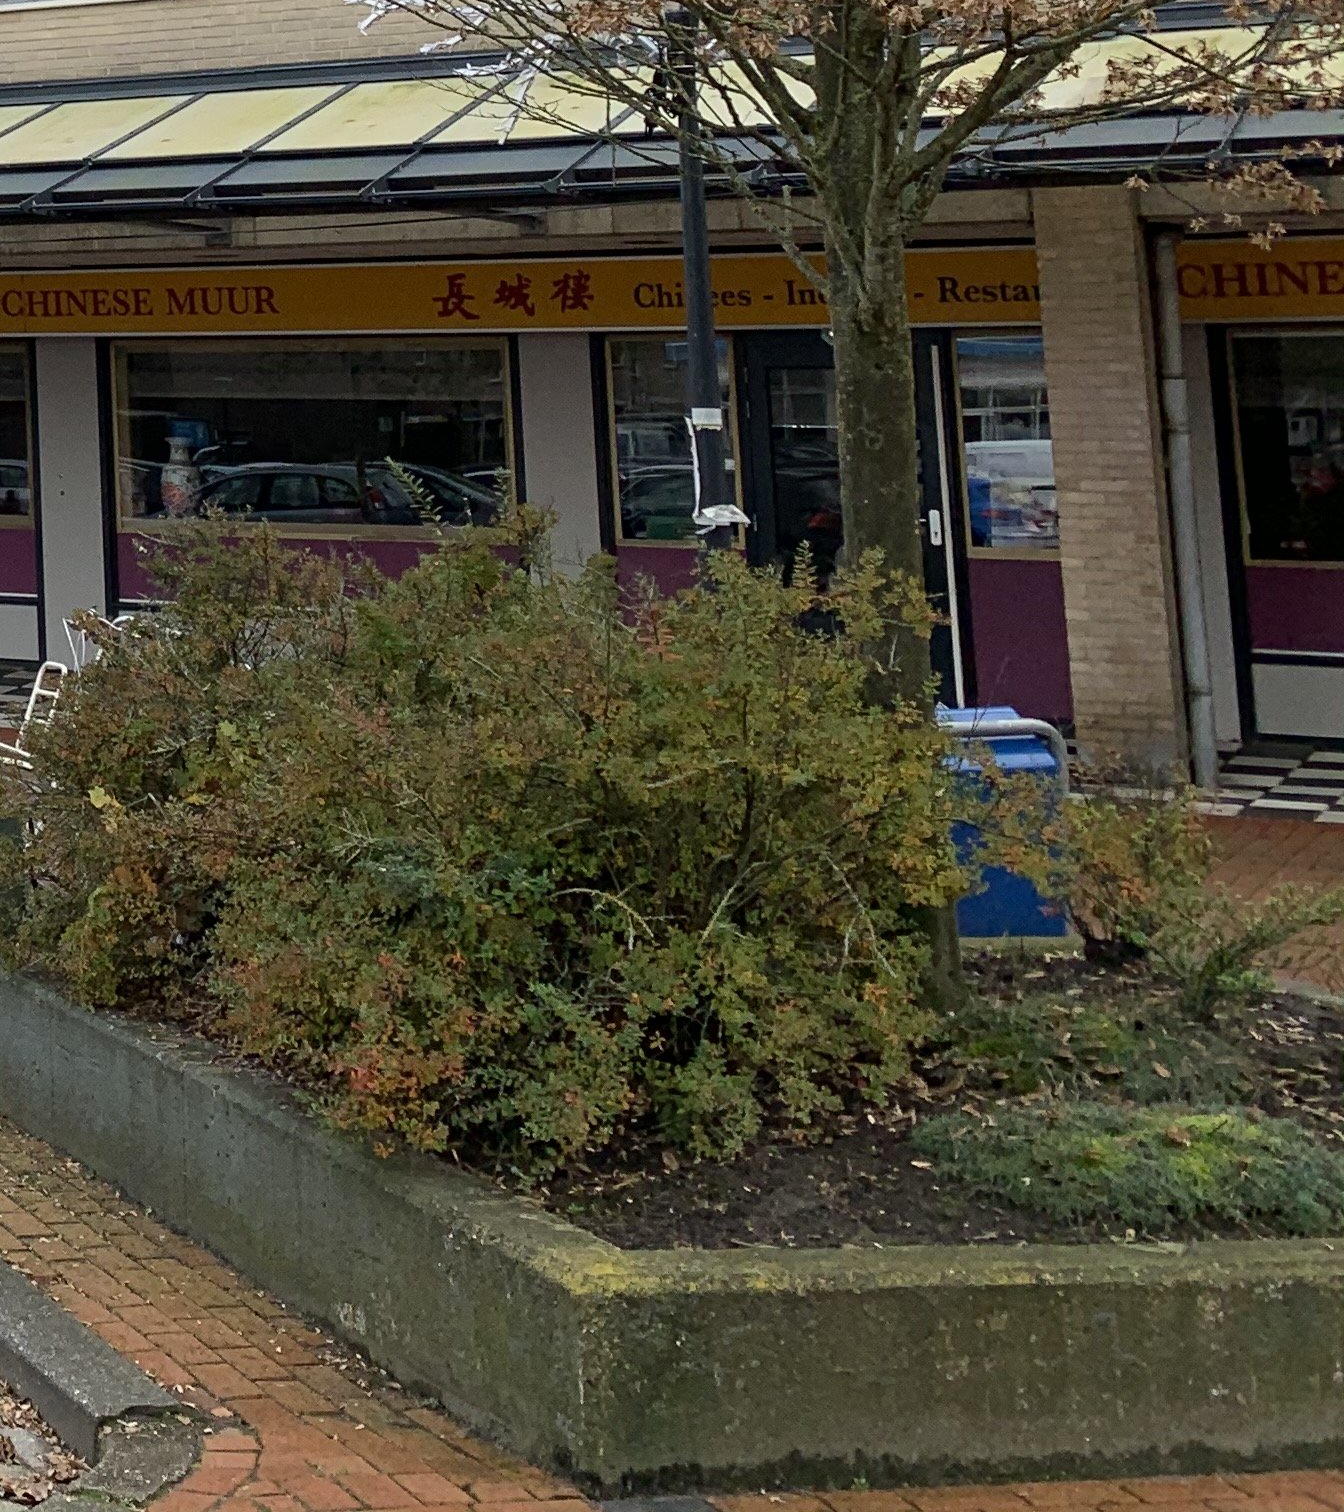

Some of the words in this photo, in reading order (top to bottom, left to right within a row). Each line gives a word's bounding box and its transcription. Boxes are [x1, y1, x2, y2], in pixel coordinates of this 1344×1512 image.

[0, 288, 154, 317] CHINESE
[165, 285, 280, 315] MUUR
[633, 282, 752, 309] Chiees
